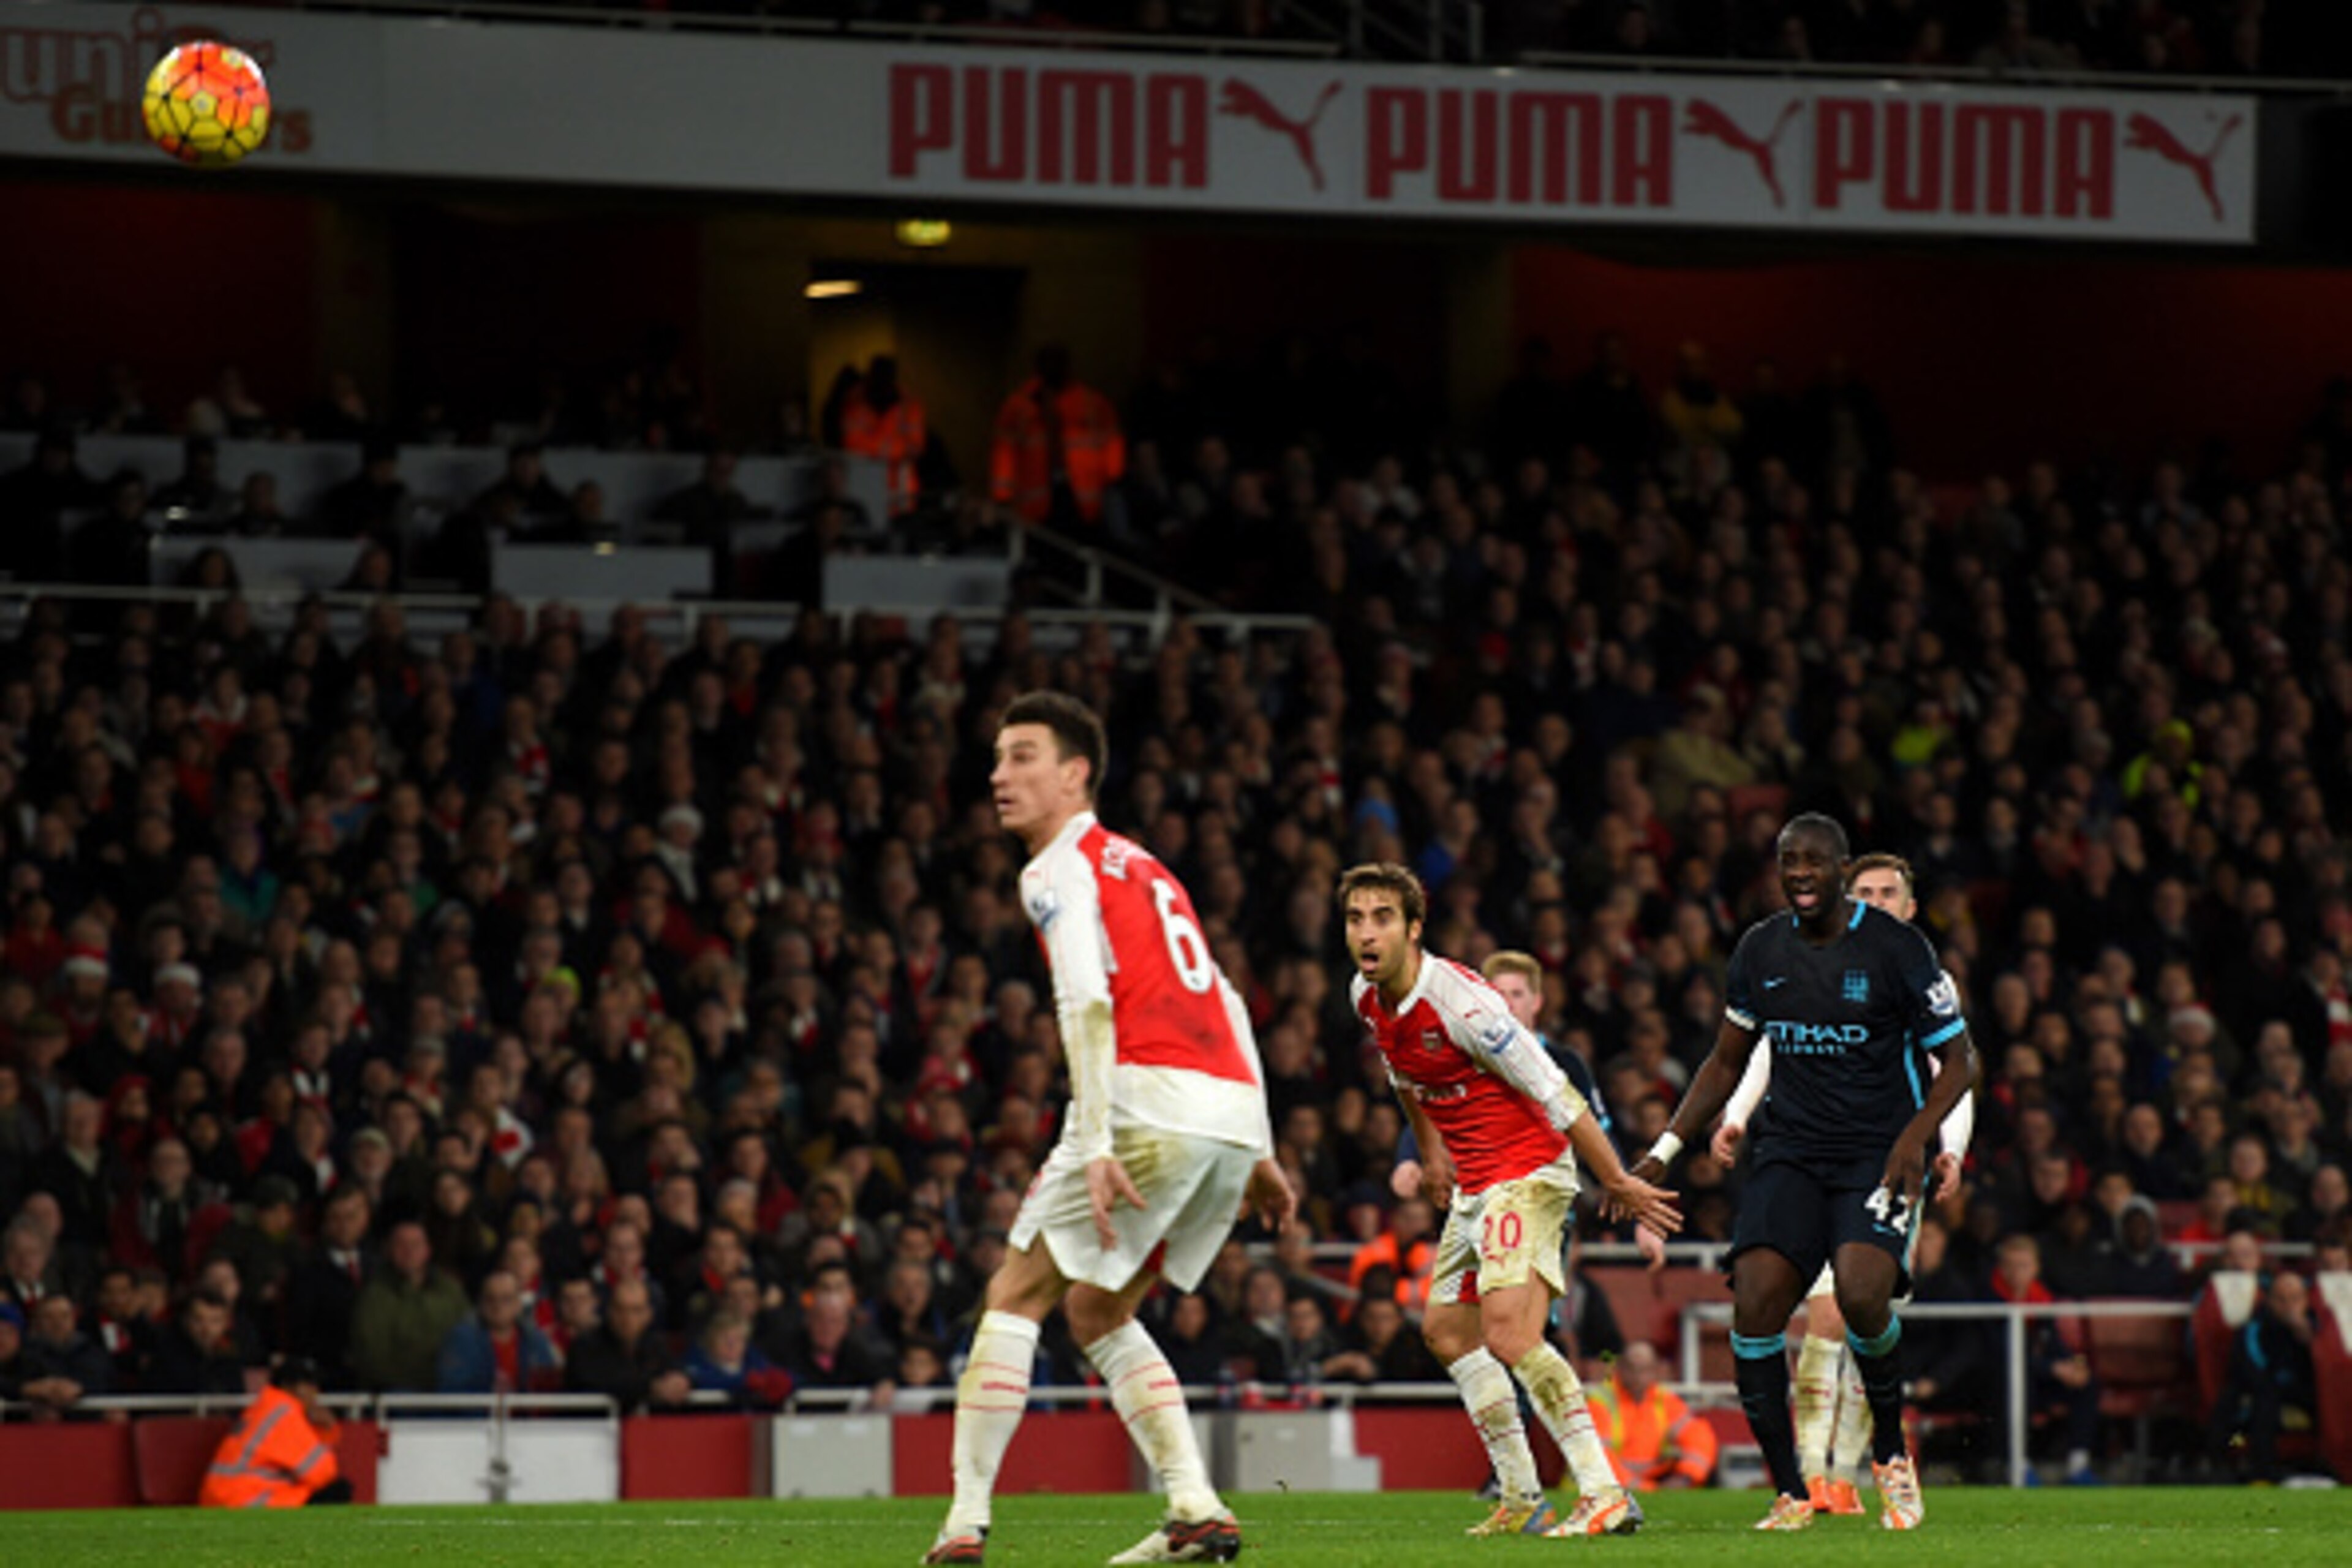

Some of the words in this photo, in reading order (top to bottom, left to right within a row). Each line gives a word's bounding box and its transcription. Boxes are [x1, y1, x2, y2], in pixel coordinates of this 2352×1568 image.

[891, 64, 1207, 186] PUMA
[1368, 88, 1672, 206] PUMA
[1815, 99, 2113, 219] PUMA
[1152, 878, 1213, 993] 6
[1763, 1019, 1871, 1044] ETIHAD
[1482, 1211, 1522, 1253] 20
